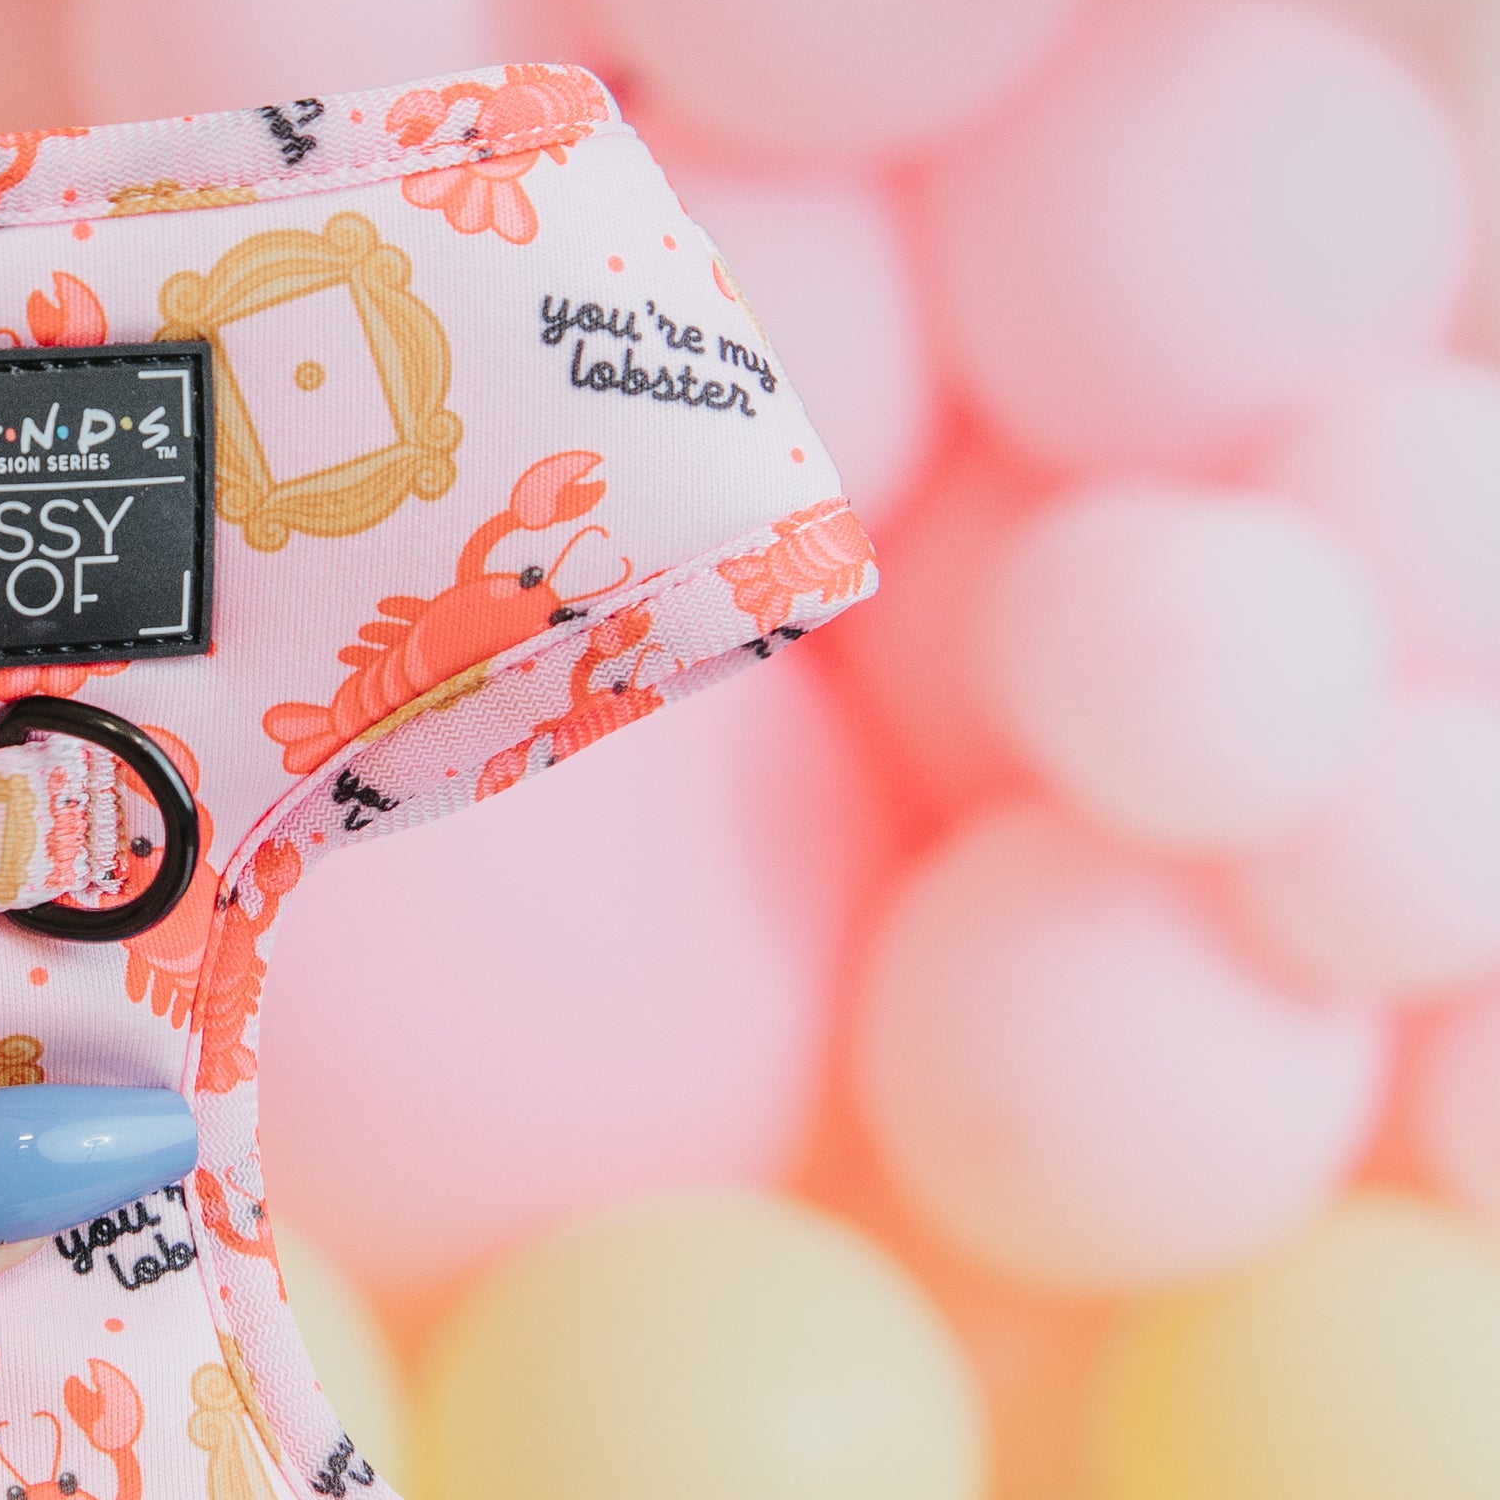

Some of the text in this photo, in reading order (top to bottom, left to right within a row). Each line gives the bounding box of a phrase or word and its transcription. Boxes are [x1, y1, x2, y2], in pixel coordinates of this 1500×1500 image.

[540, 294, 778, 393] you're my
[570, 338, 757, 418] lobster
[46, 453, 111, 472] SERIES
